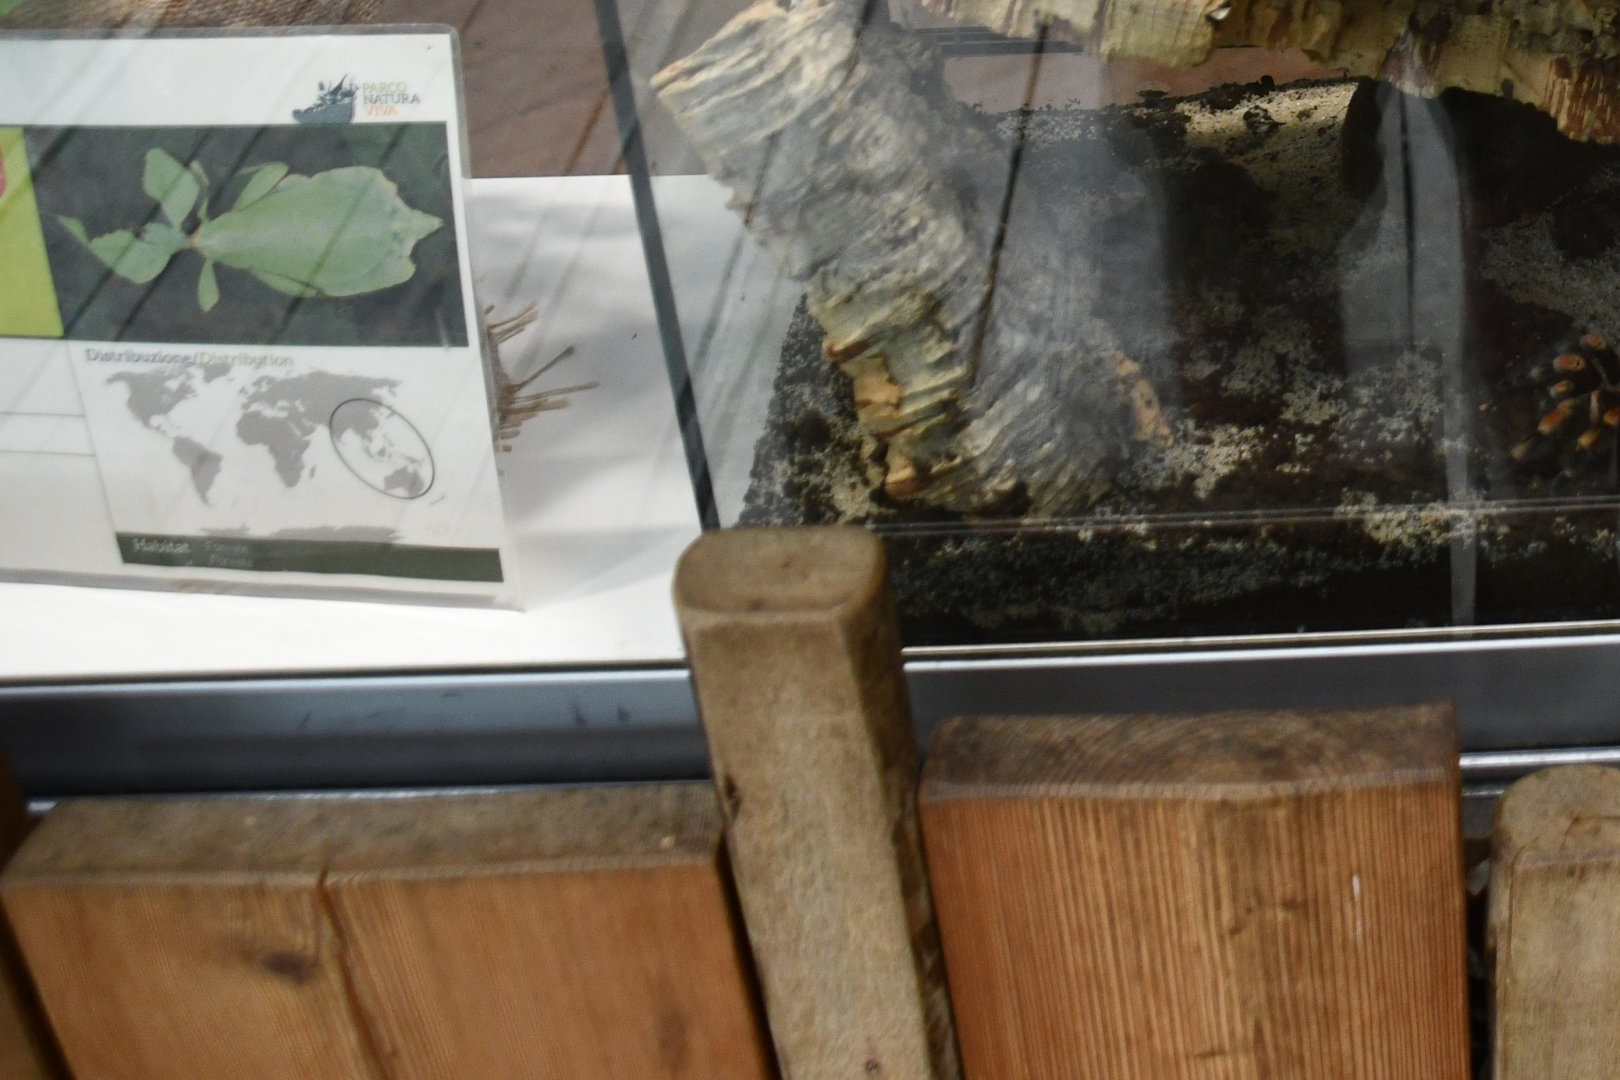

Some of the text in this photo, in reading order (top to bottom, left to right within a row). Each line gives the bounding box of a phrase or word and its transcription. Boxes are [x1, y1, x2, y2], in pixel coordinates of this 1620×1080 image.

[362, 82, 408, 93] PARCO
[363, 93, 421, 105] NATURA
[366, 105, 398, 116] VIVA
